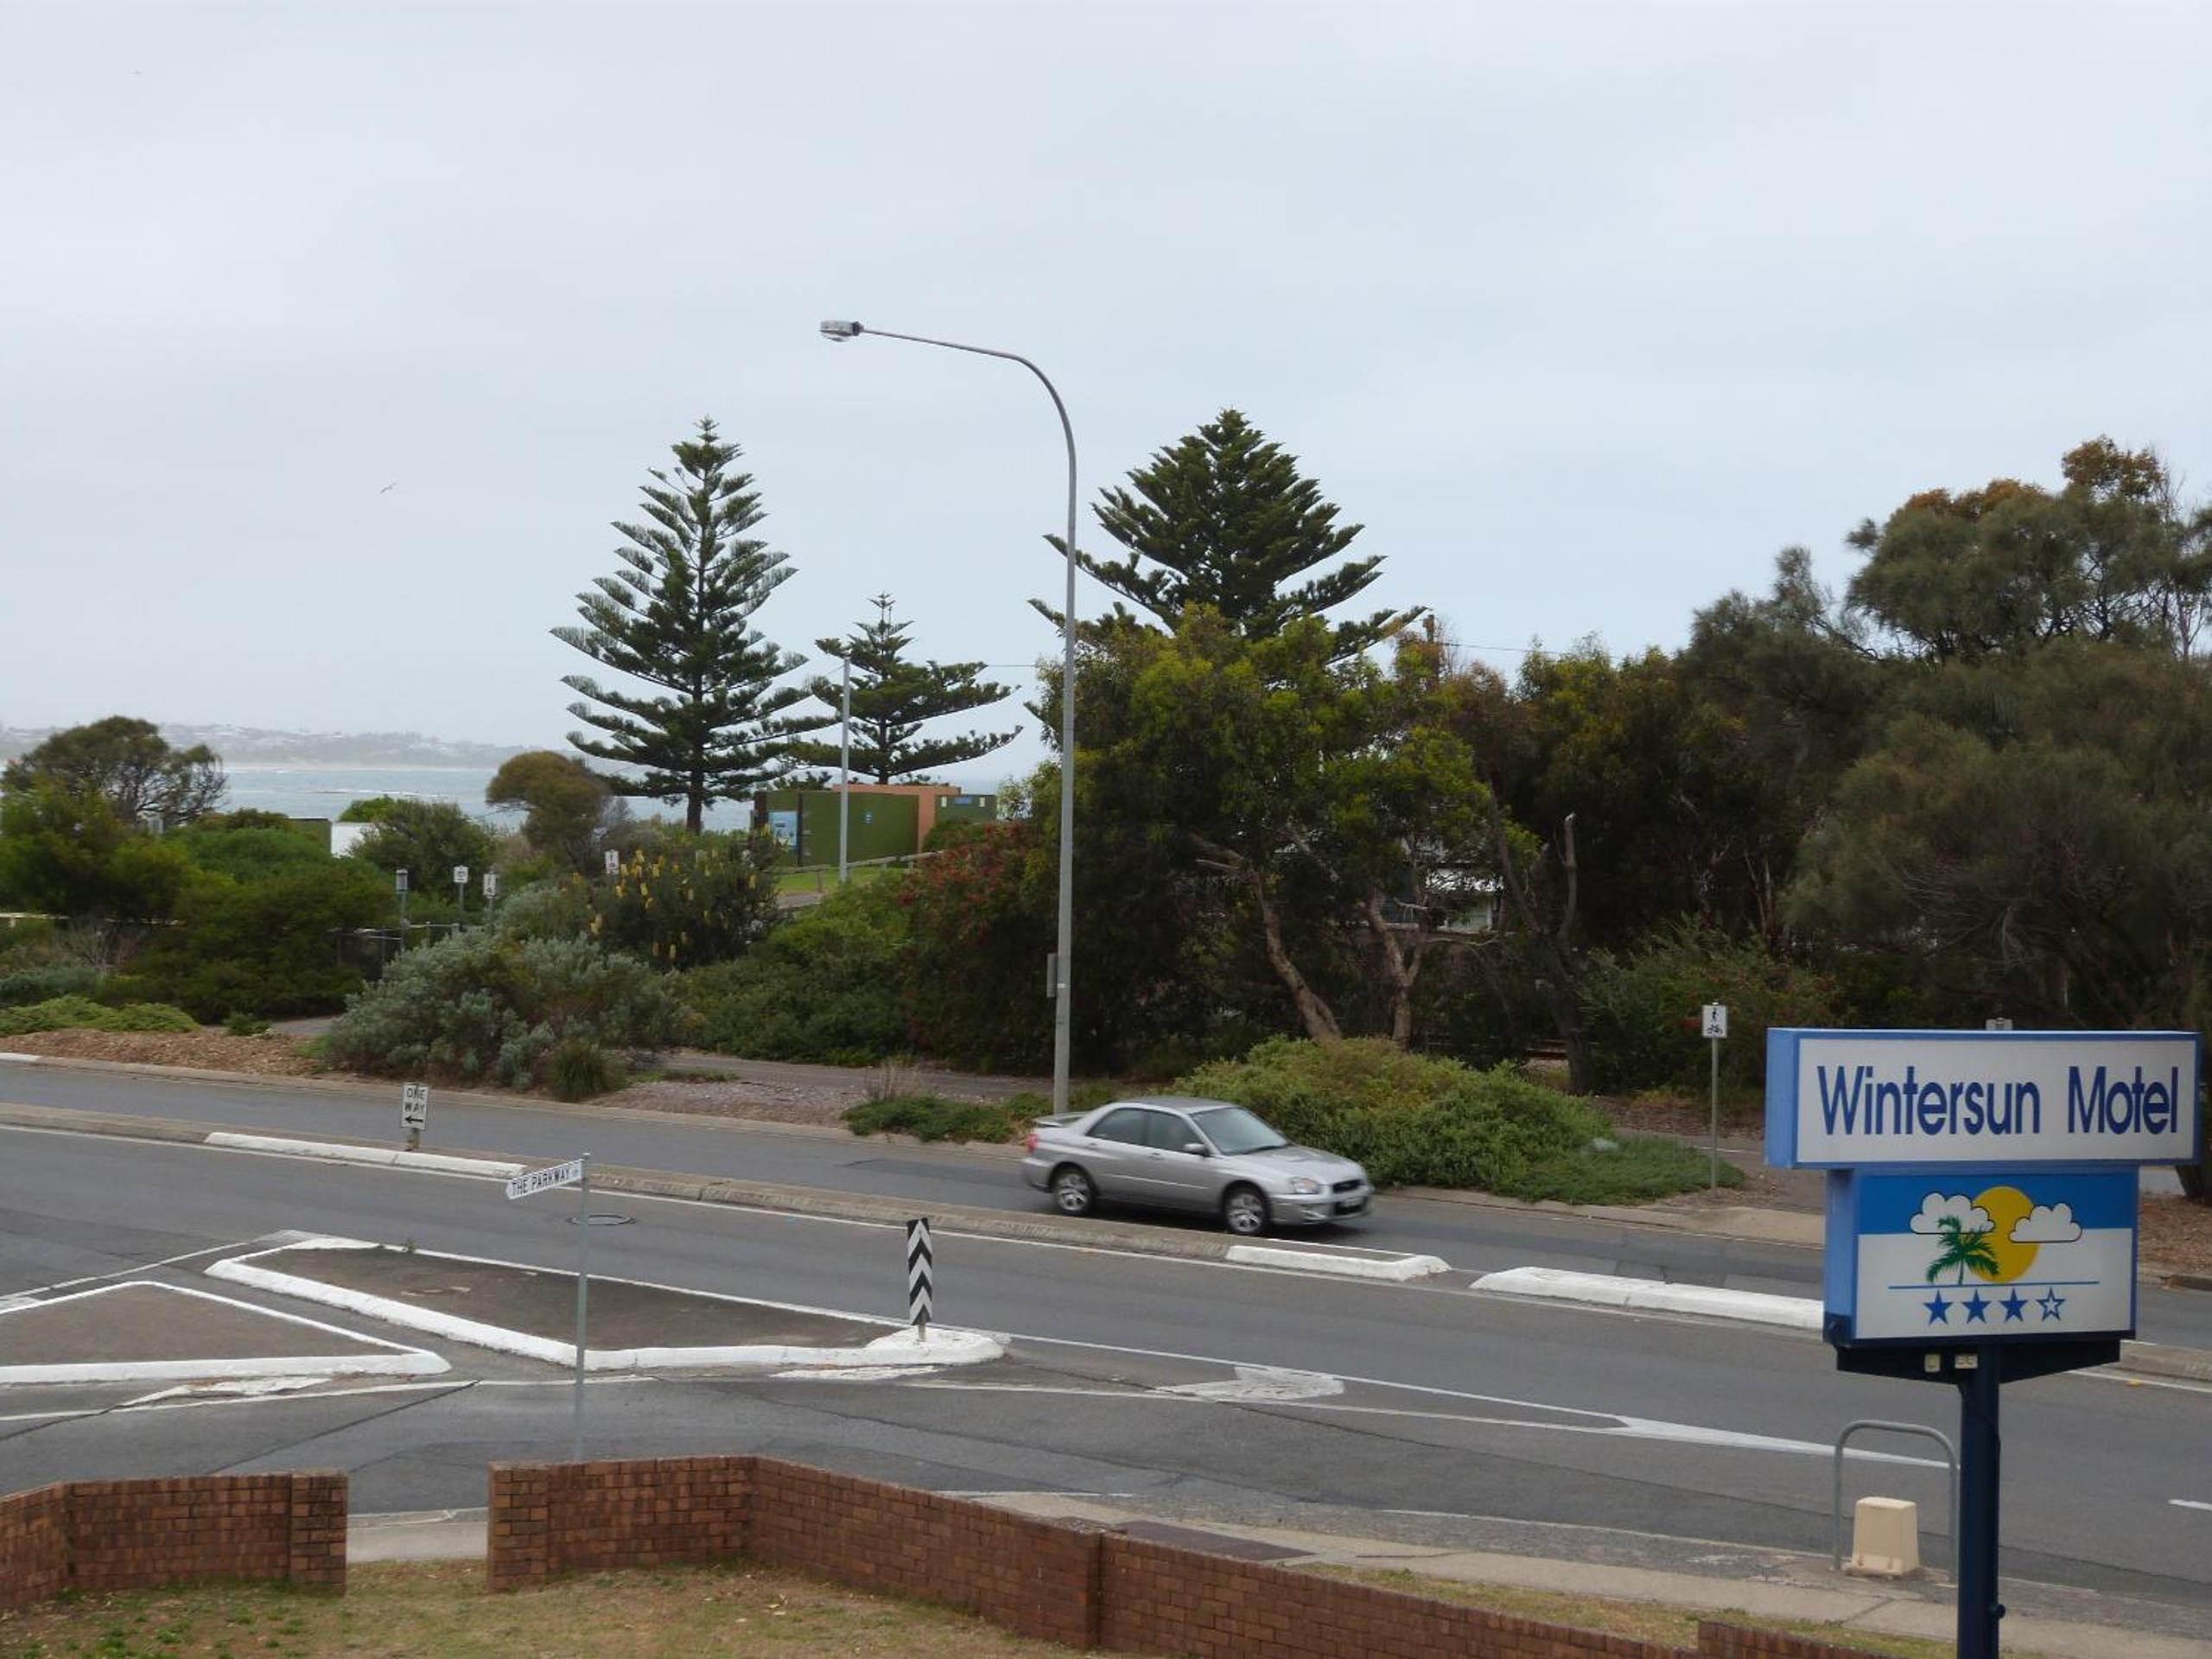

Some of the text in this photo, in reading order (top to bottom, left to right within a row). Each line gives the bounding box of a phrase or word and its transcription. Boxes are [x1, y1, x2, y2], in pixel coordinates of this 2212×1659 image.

[1817, 1065, 2178, 1135] Wintersun Motel
[512, 1166, 569, 1197] THE PARKWAY
